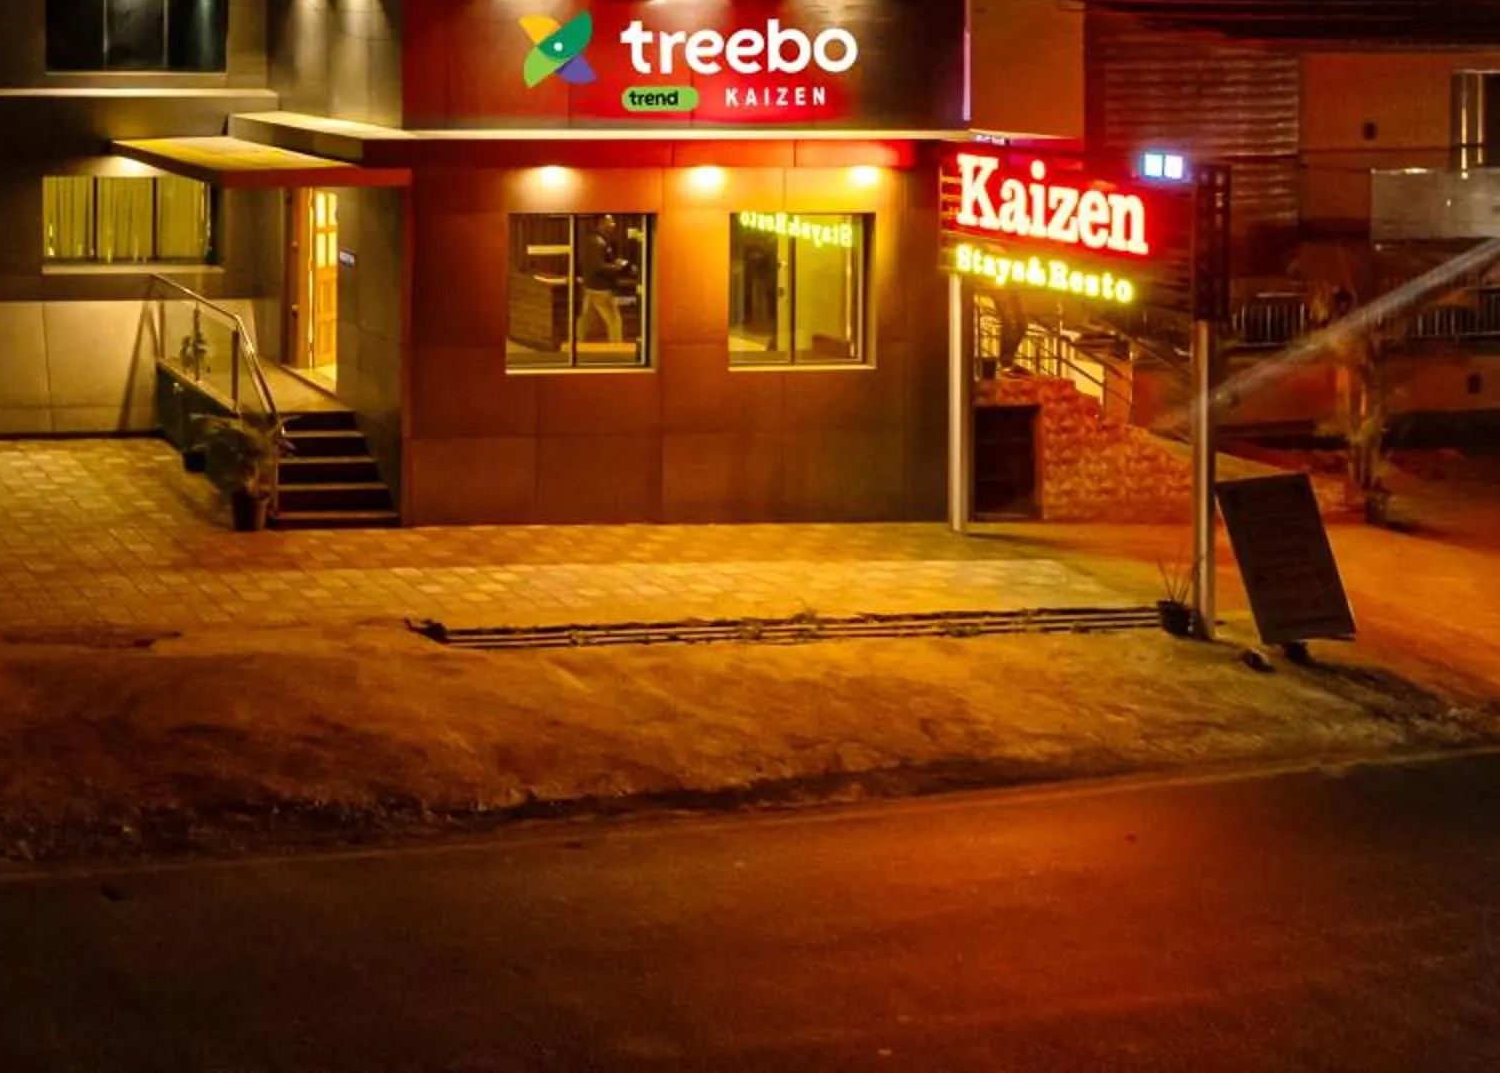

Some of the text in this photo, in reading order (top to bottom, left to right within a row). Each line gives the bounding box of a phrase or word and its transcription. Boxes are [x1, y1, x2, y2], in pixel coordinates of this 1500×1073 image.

[620, 18, 858, 74] treebo
[628, 90, 679, 106] trend
[725, 87, 826, 107] KAIZEN
[957, 153, 1148, 255] Kaizen
